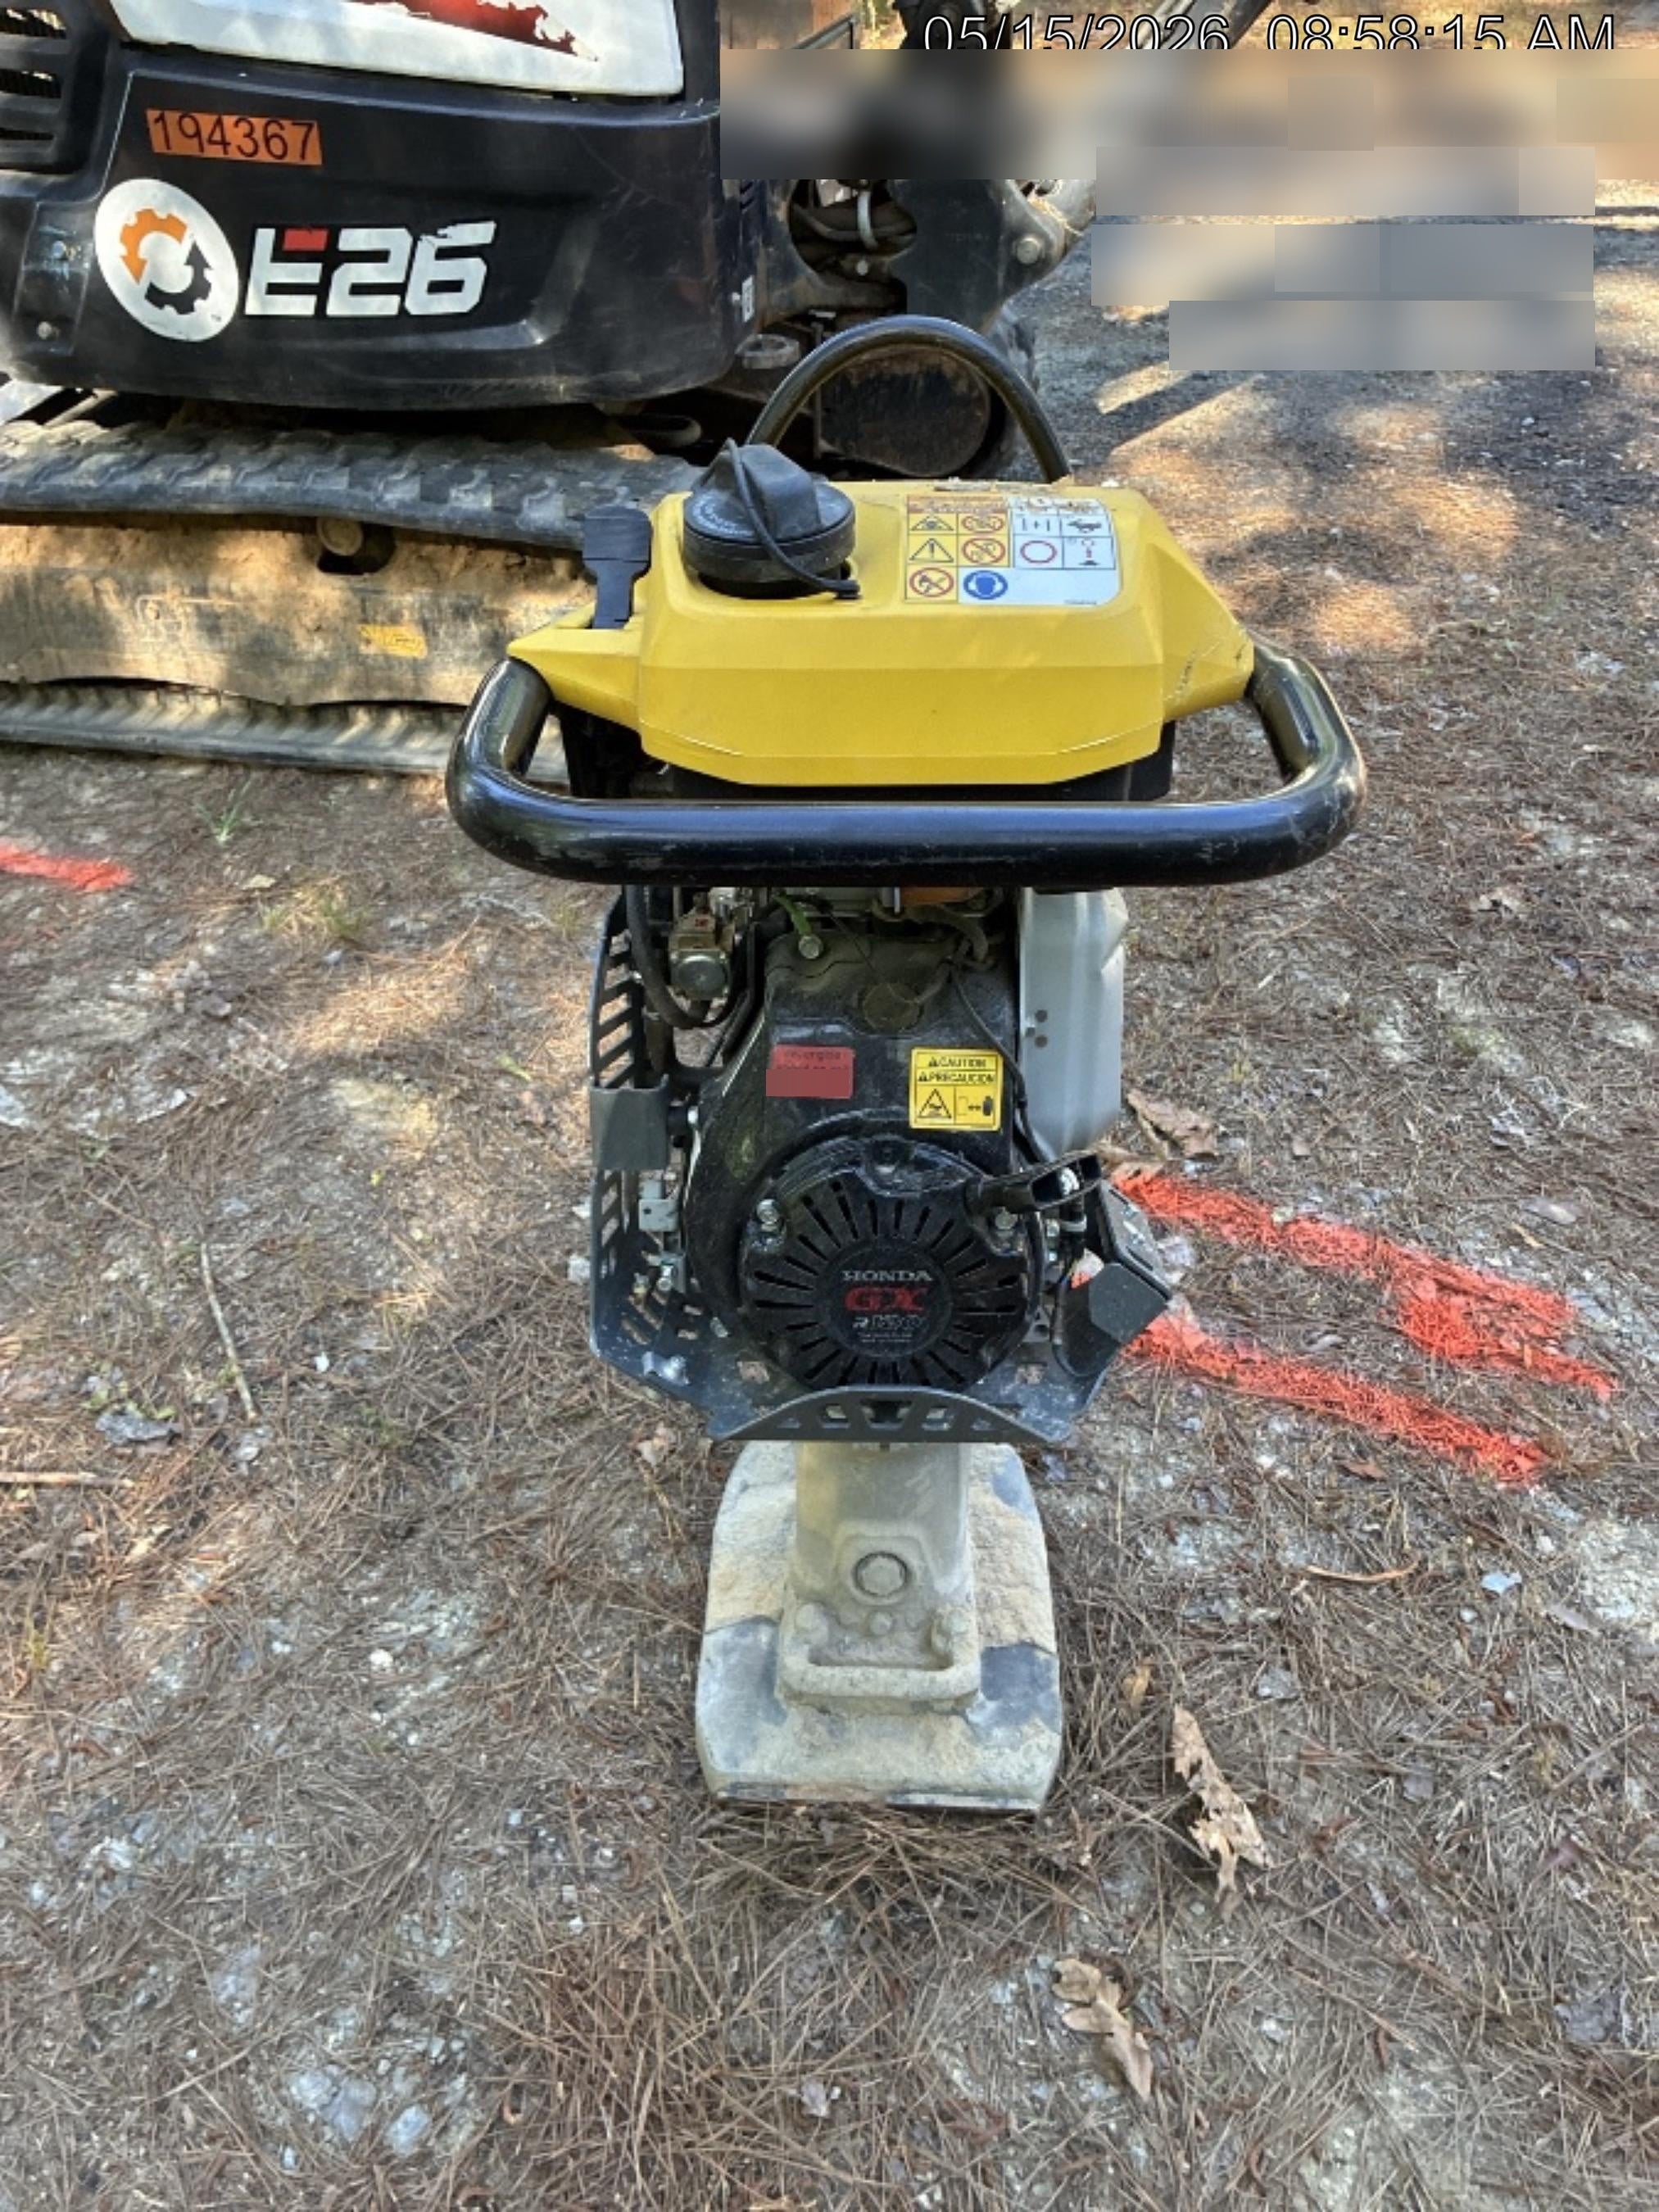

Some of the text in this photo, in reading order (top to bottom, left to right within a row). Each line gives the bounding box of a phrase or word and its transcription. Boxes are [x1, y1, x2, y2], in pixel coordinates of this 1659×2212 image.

[154, 112, 315, 161] 194367
[245, 220, 496, 317] E26
[842, 1271, 932, 1281] HONDA
[845, 1286, 929, 1312] GX
